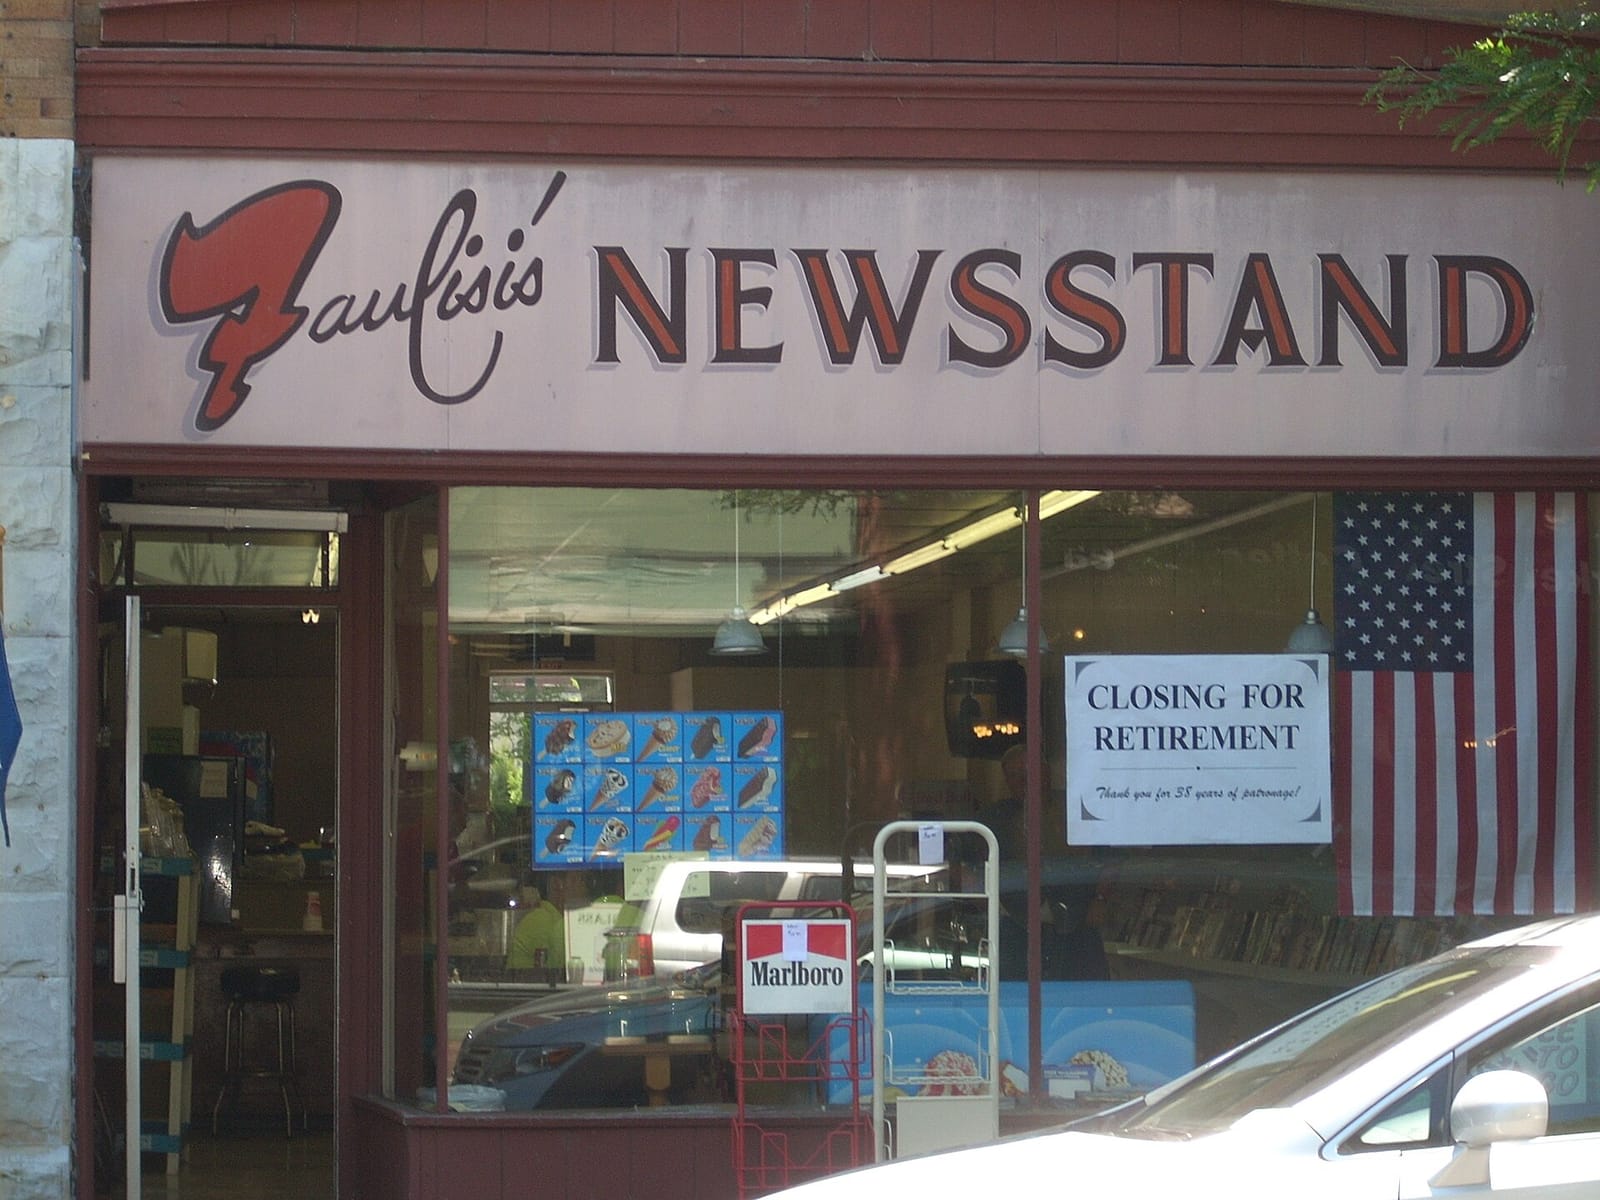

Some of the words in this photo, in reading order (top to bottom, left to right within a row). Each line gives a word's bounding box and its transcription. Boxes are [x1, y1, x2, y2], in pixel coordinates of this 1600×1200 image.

[593, 245, 1535, 369] NEWSSTAND
[1087, 683, 1226, 711] CLOSING
[1243, 683, 1305, 710] FOR
[1094, 725, 1300, 751] RETIREMENT
[1095, 786, 1130, 799] Thank
[1133, 789, 1152, 801] you
[1155, 787, 1171, 802] for
[1195, 788, 1224, 801] years
[1227, 787, 1239, 802] of
[1241, 785, 1302, 801] patronage!
[751, 960, 844, 987] Marlboro
